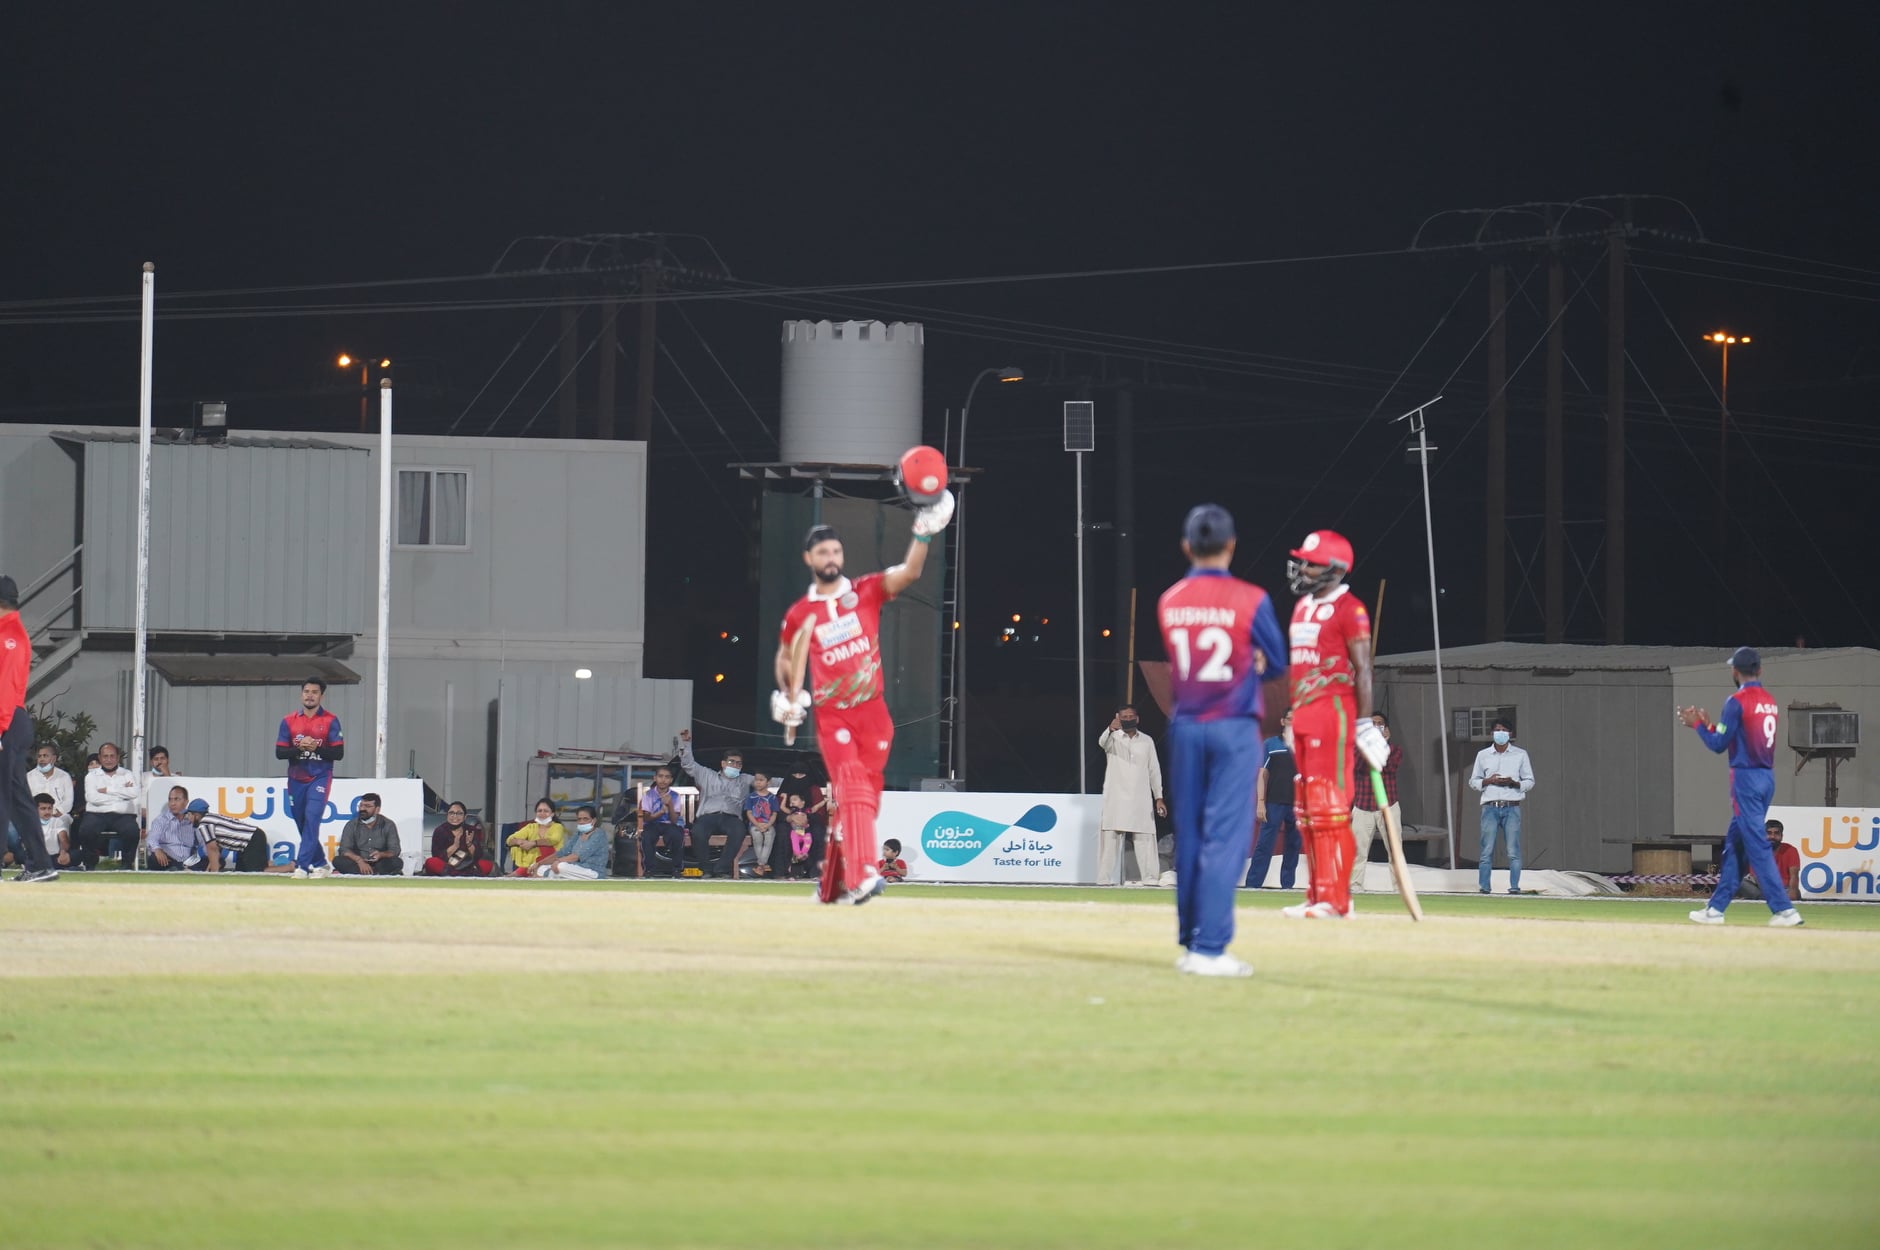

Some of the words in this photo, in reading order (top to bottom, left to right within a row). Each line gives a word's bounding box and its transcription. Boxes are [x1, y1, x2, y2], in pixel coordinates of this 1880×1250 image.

[821, 636, 871, 666] OMAN
[1170, 627, 1233, 682] 12
[1290, 647, 1320, 665] MAN
[1763, 714, 1777, 748] 9
[934, 826, 974, 839] مزون
[926, 838, 982, 849] mazoon
[1002, 838, 1026, 853] أحلى
[1028, 841, 1053, 854] حياة
[993, 857, 1022, 867] Taste
[1024, 857, 1039, 867] for
[1044, 858, 1062, 867] life
[1800, 861, 1880, 895] Om
